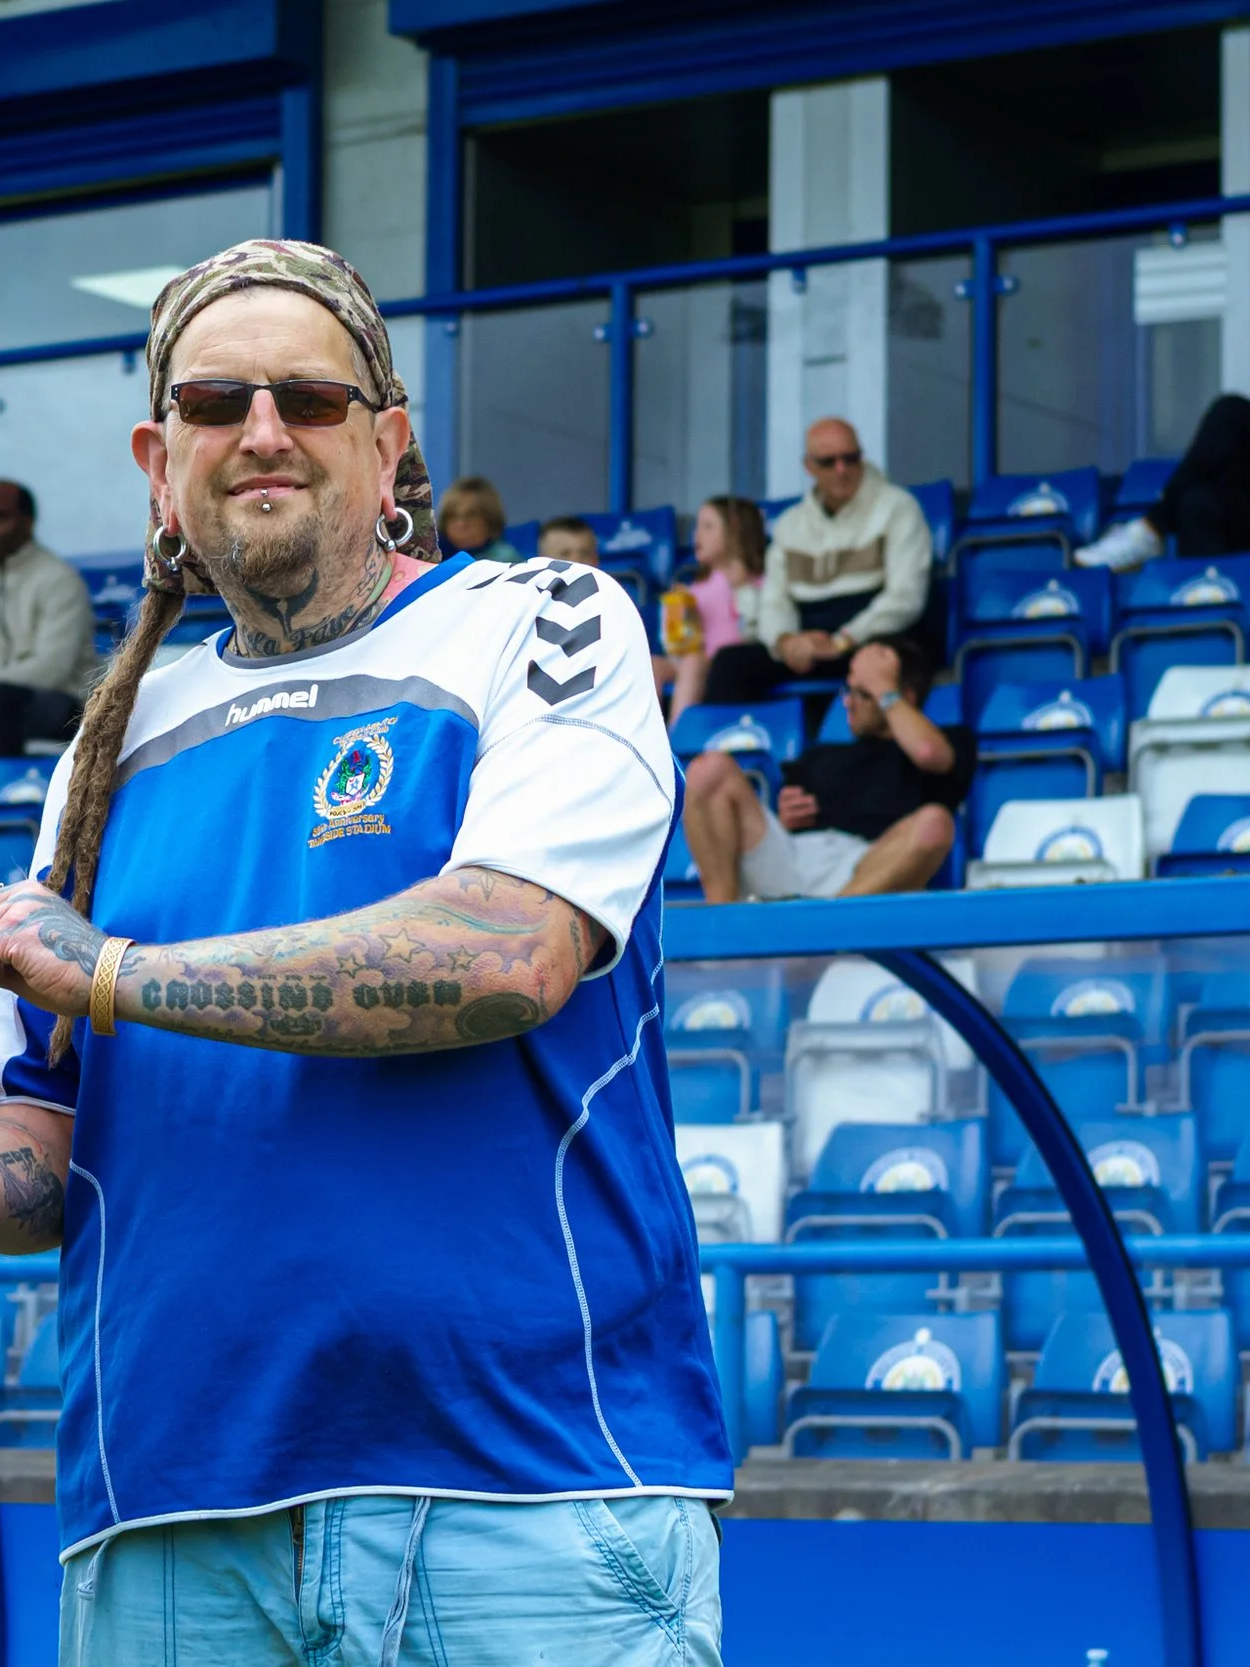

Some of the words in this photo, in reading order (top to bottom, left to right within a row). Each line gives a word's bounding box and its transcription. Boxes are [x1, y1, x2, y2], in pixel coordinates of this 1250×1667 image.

[224, 684, 318, 727] hummel
[346, 824, 391, 836] STADIUM
[142, 977, 333, 1012] CROSSING
